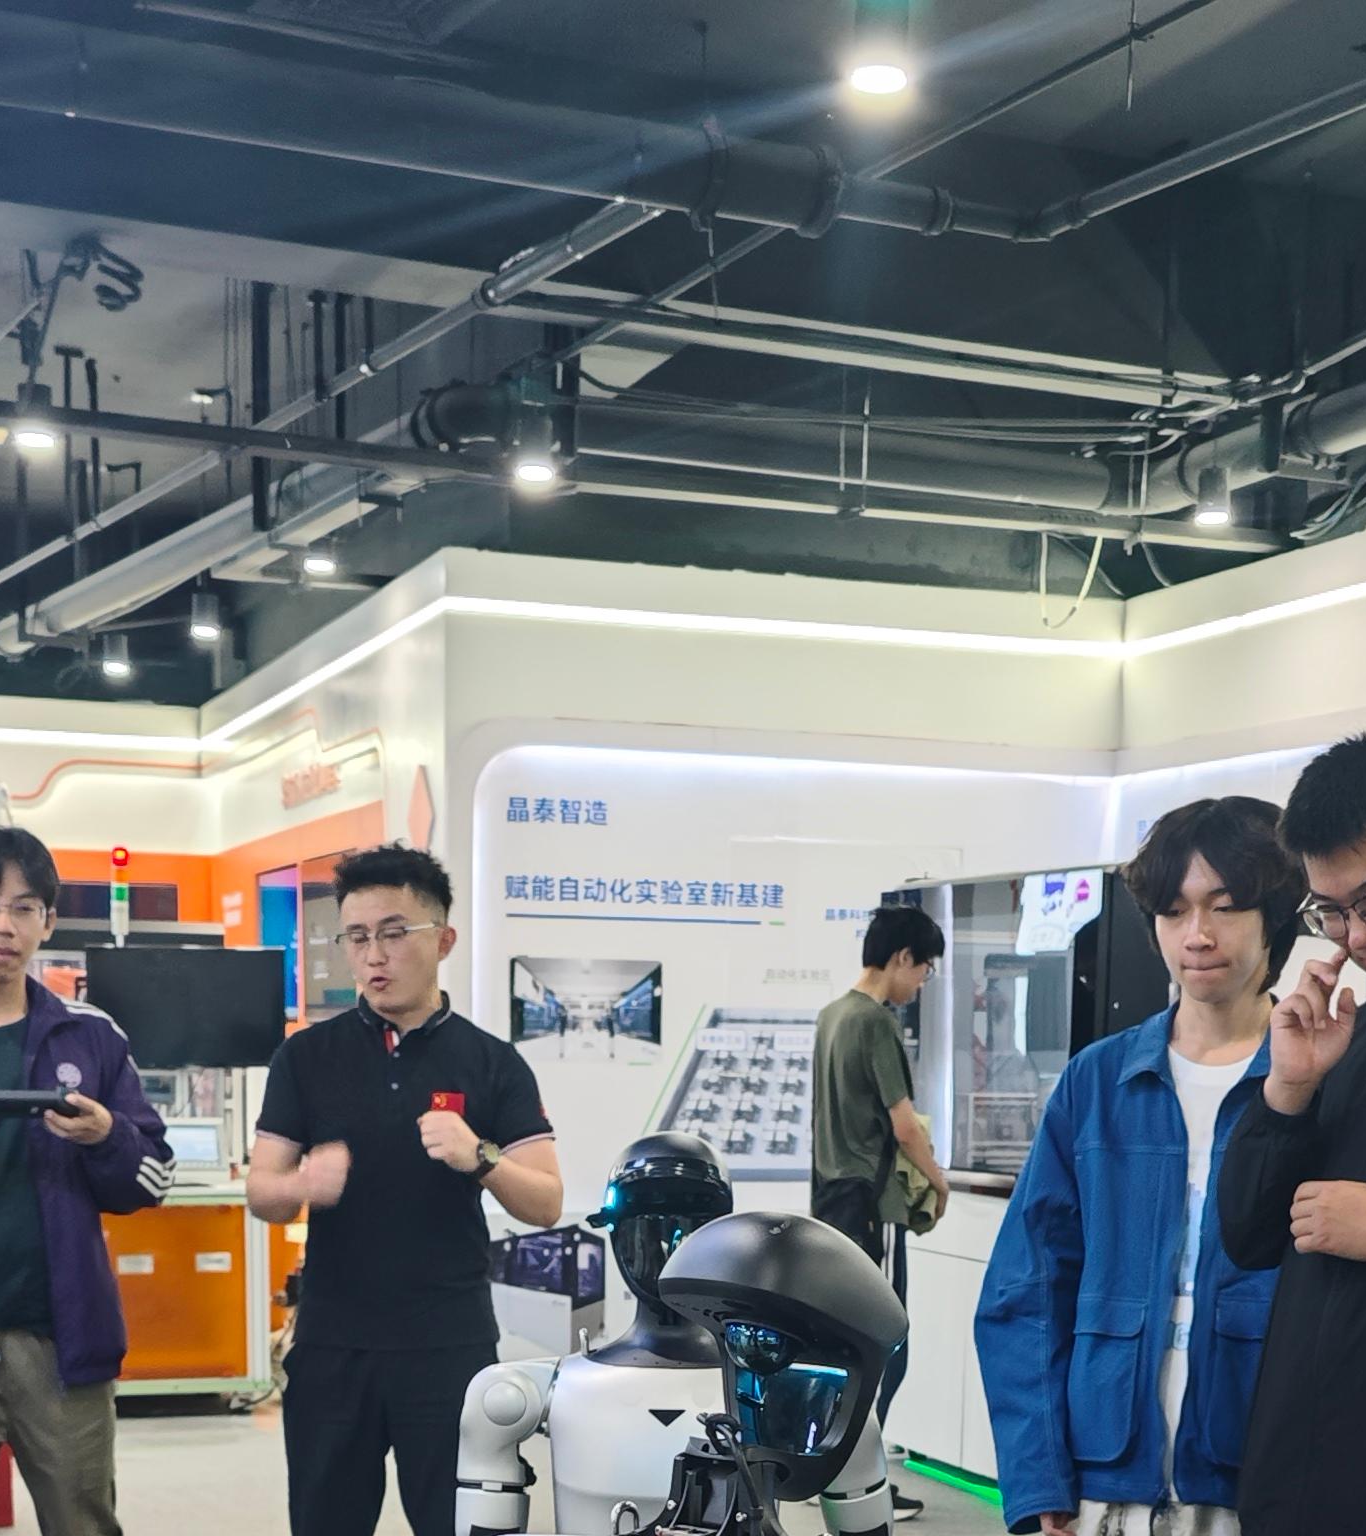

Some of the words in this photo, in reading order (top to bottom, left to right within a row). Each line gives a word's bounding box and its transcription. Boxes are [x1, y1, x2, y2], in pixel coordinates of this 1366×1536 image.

[506, 796, 608, 826] 晶泰智造
[505, 874, 785, 908] 赋能自动化实验室新基建
